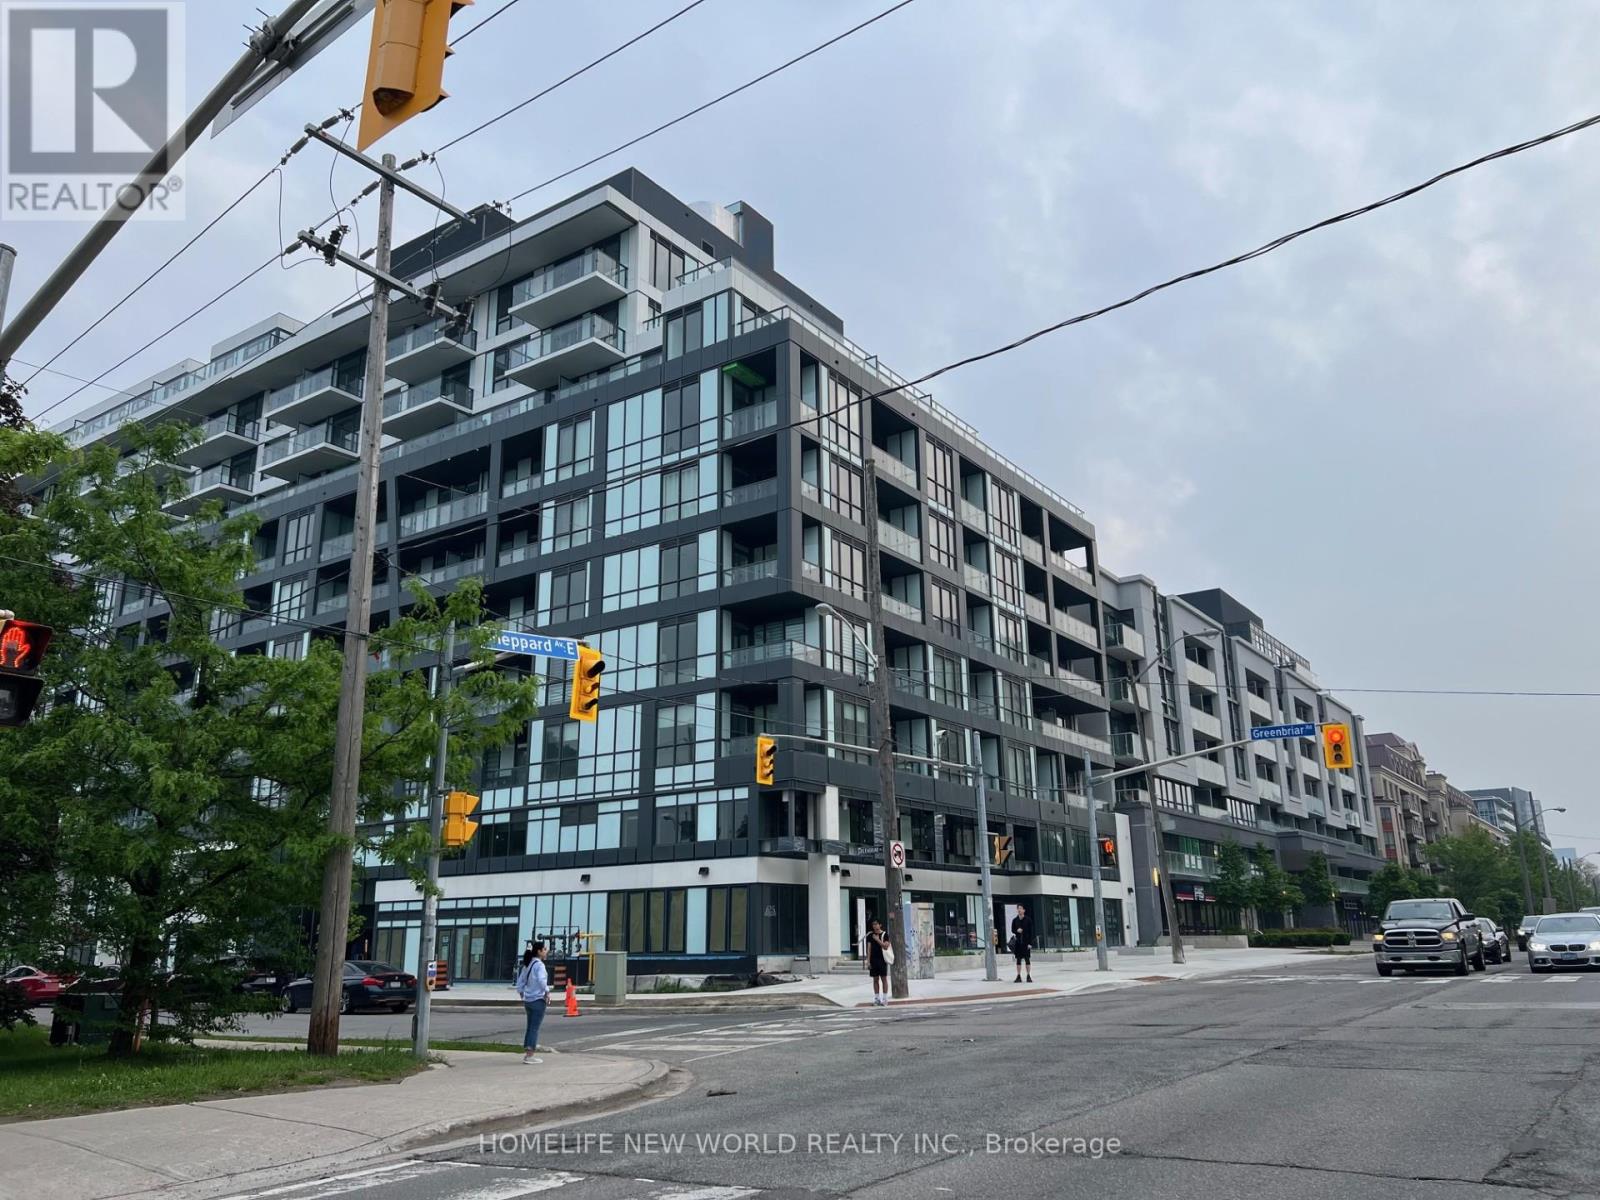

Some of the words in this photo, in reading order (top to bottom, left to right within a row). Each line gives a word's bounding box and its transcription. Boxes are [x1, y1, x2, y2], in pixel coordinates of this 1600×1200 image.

[491, 635, 552, 652] eppard
[567, 642, 576, 656] E
[1252, 726, 1304, 739] Greenbriar
